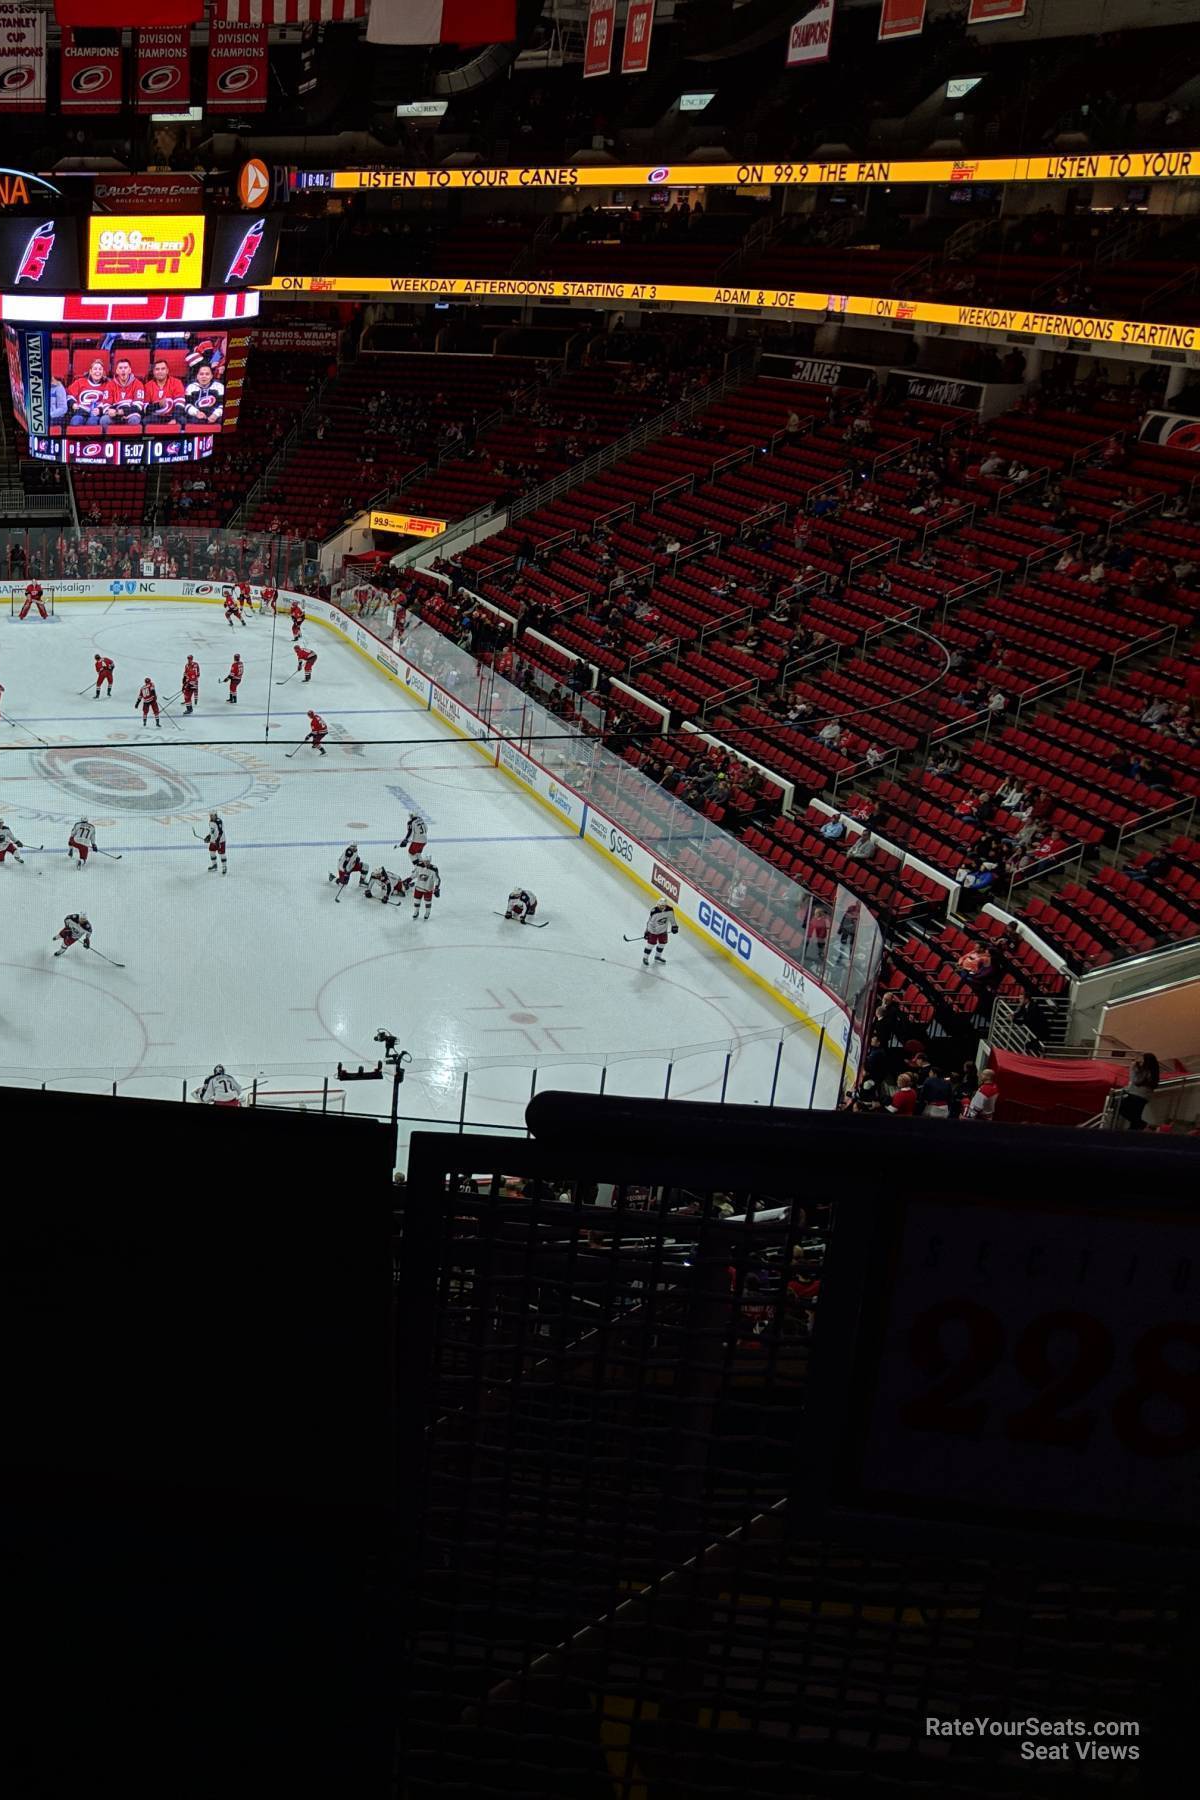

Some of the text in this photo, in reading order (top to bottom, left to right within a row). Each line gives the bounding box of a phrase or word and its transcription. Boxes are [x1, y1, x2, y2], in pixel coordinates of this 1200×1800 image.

[7, 33, 26, 43] CUP
[139, 34, 182, 44] DIVISION
[217, 33, 259, 43] DIVISION
[791, 19, 830, 49] CHAMPIONS
[64, 47, 120, 57] CHAMPIONS
[134, 48, 188, 58] HAMPIONS
[211, 47, 264, 57] CHAMPIONS
[1046, 152, 1192, 179] LISTEN TO YOUR
[308, 173, 324, 187] 6:40
[358, 168, 578, 188] LISTEN TO YOUR CANES
[736, 163, 890, 184] ON 99.9 THE FAN
[169, 185, 200, 196] GAME
[96, 251, 180, 274] ESPN
[281, 277, 303, 290] ON
[390, 279, 658, 300] WEEKDAY AFTERNOONS STARTING AT 3
[714, 288, 796, 307] ADAM & JOE
[876, 299, 893, 315] ON
[958, 307, 1195, 348] WEEKDAY AFTERNOONS STARTING
[262, 331, 337, 340] NACHOS, WRAPS
[792, 360, 841, 385] CANES
[105, 443, 114, 457] 0
[125, 444, 144, 457] 5:07
[155, 442, 163, 457] 0
[373, 516, 389, 527] 99.9
[407, 518, 441, 534] ESPN
[139, 582, 156, 593] NC
[182, 587, 195, 596] LIVE
[411, 676, 426, 692] pepsi
[79, 827, 92, 838] 77
[653, 869, 679, 897] Lenovo
[698, 900, 753, 961] GEICO
[782, 963, 806, 993] DNA
